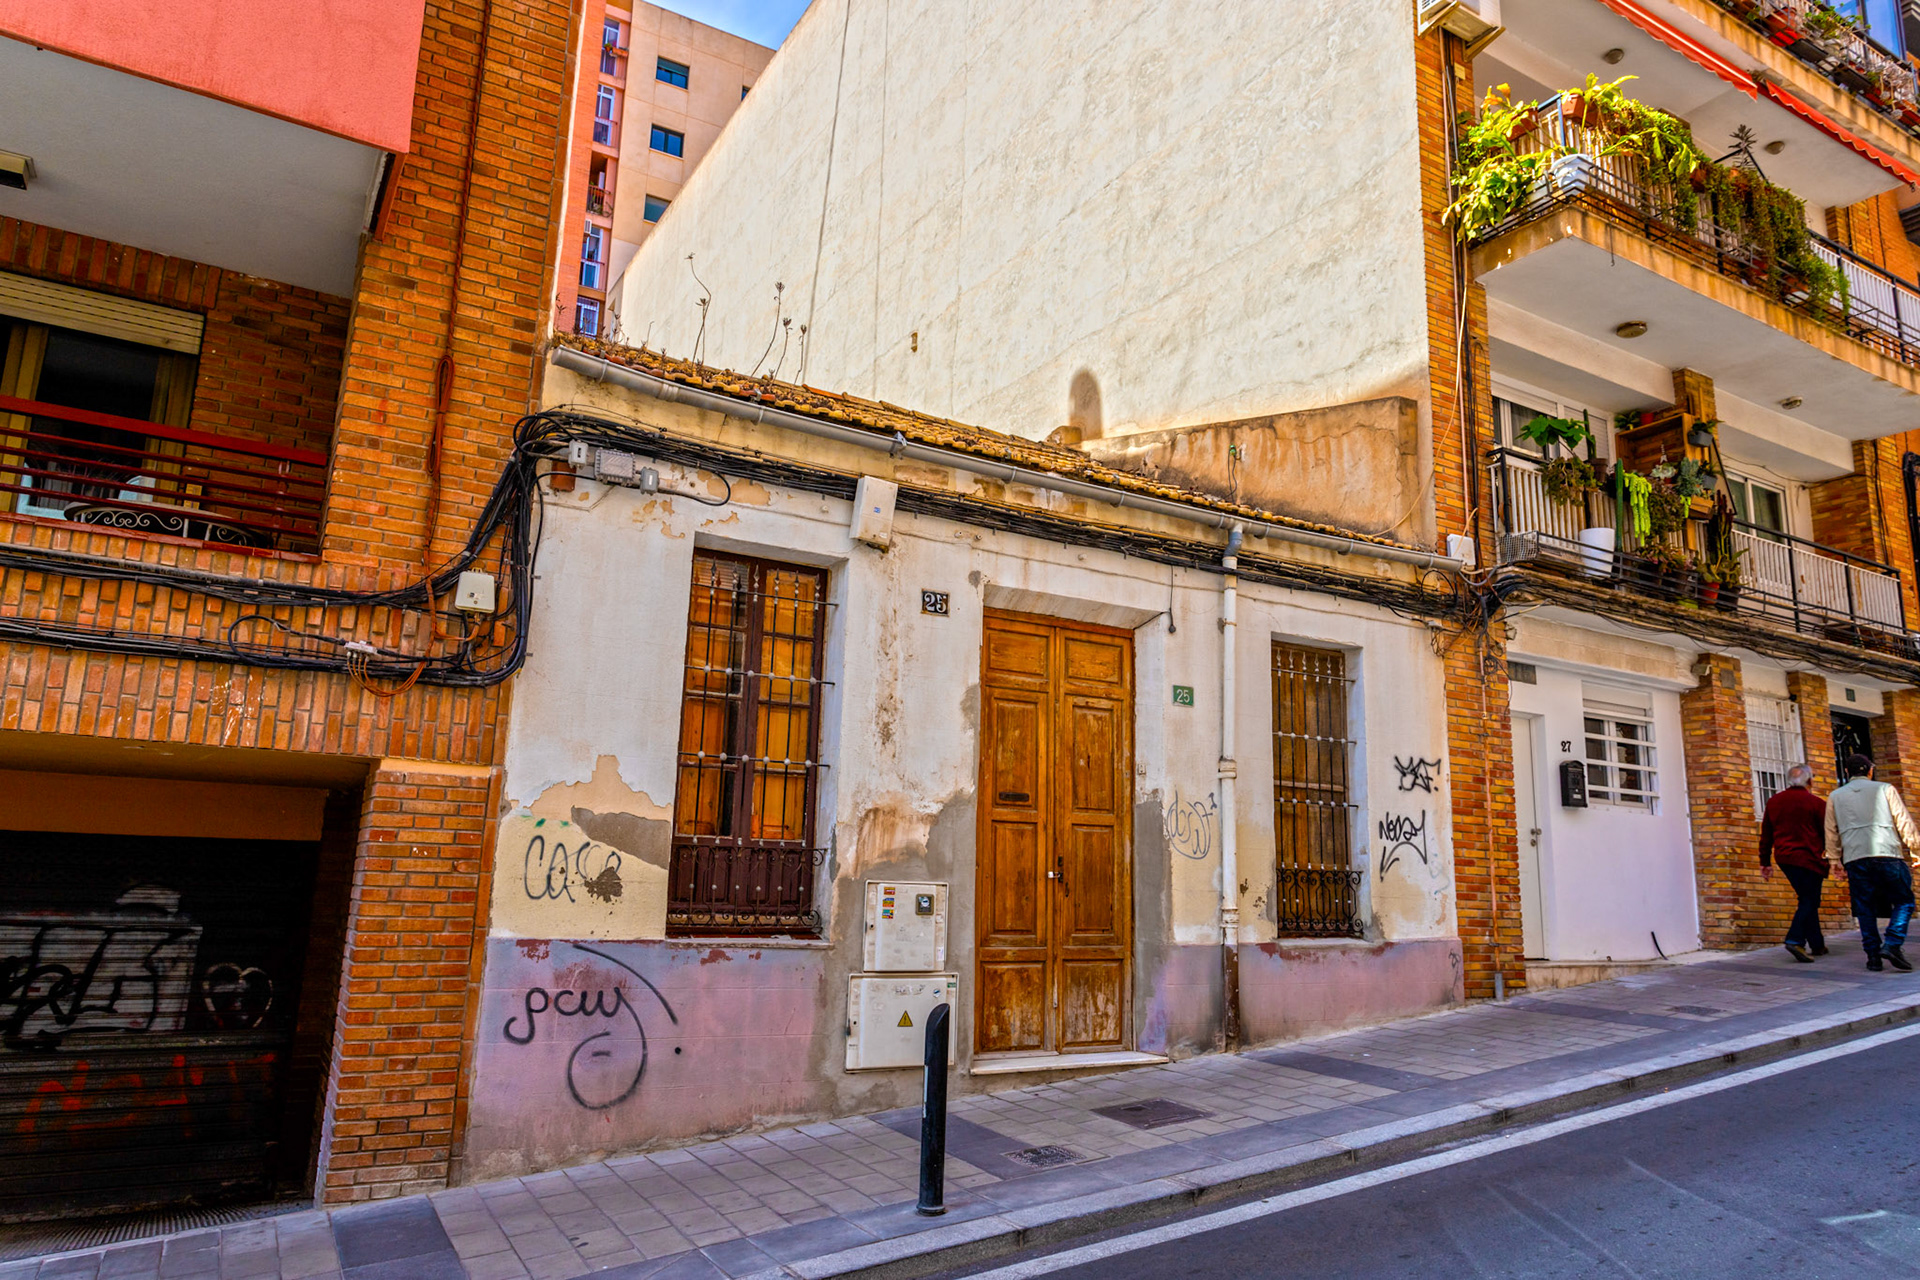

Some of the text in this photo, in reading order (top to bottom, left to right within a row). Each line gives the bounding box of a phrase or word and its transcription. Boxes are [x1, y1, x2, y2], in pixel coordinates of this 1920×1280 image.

[924, 592, 947, 613] 25
[1176, 688, 1190, 703] 25
[1561, 741, 1571, 753] 27
